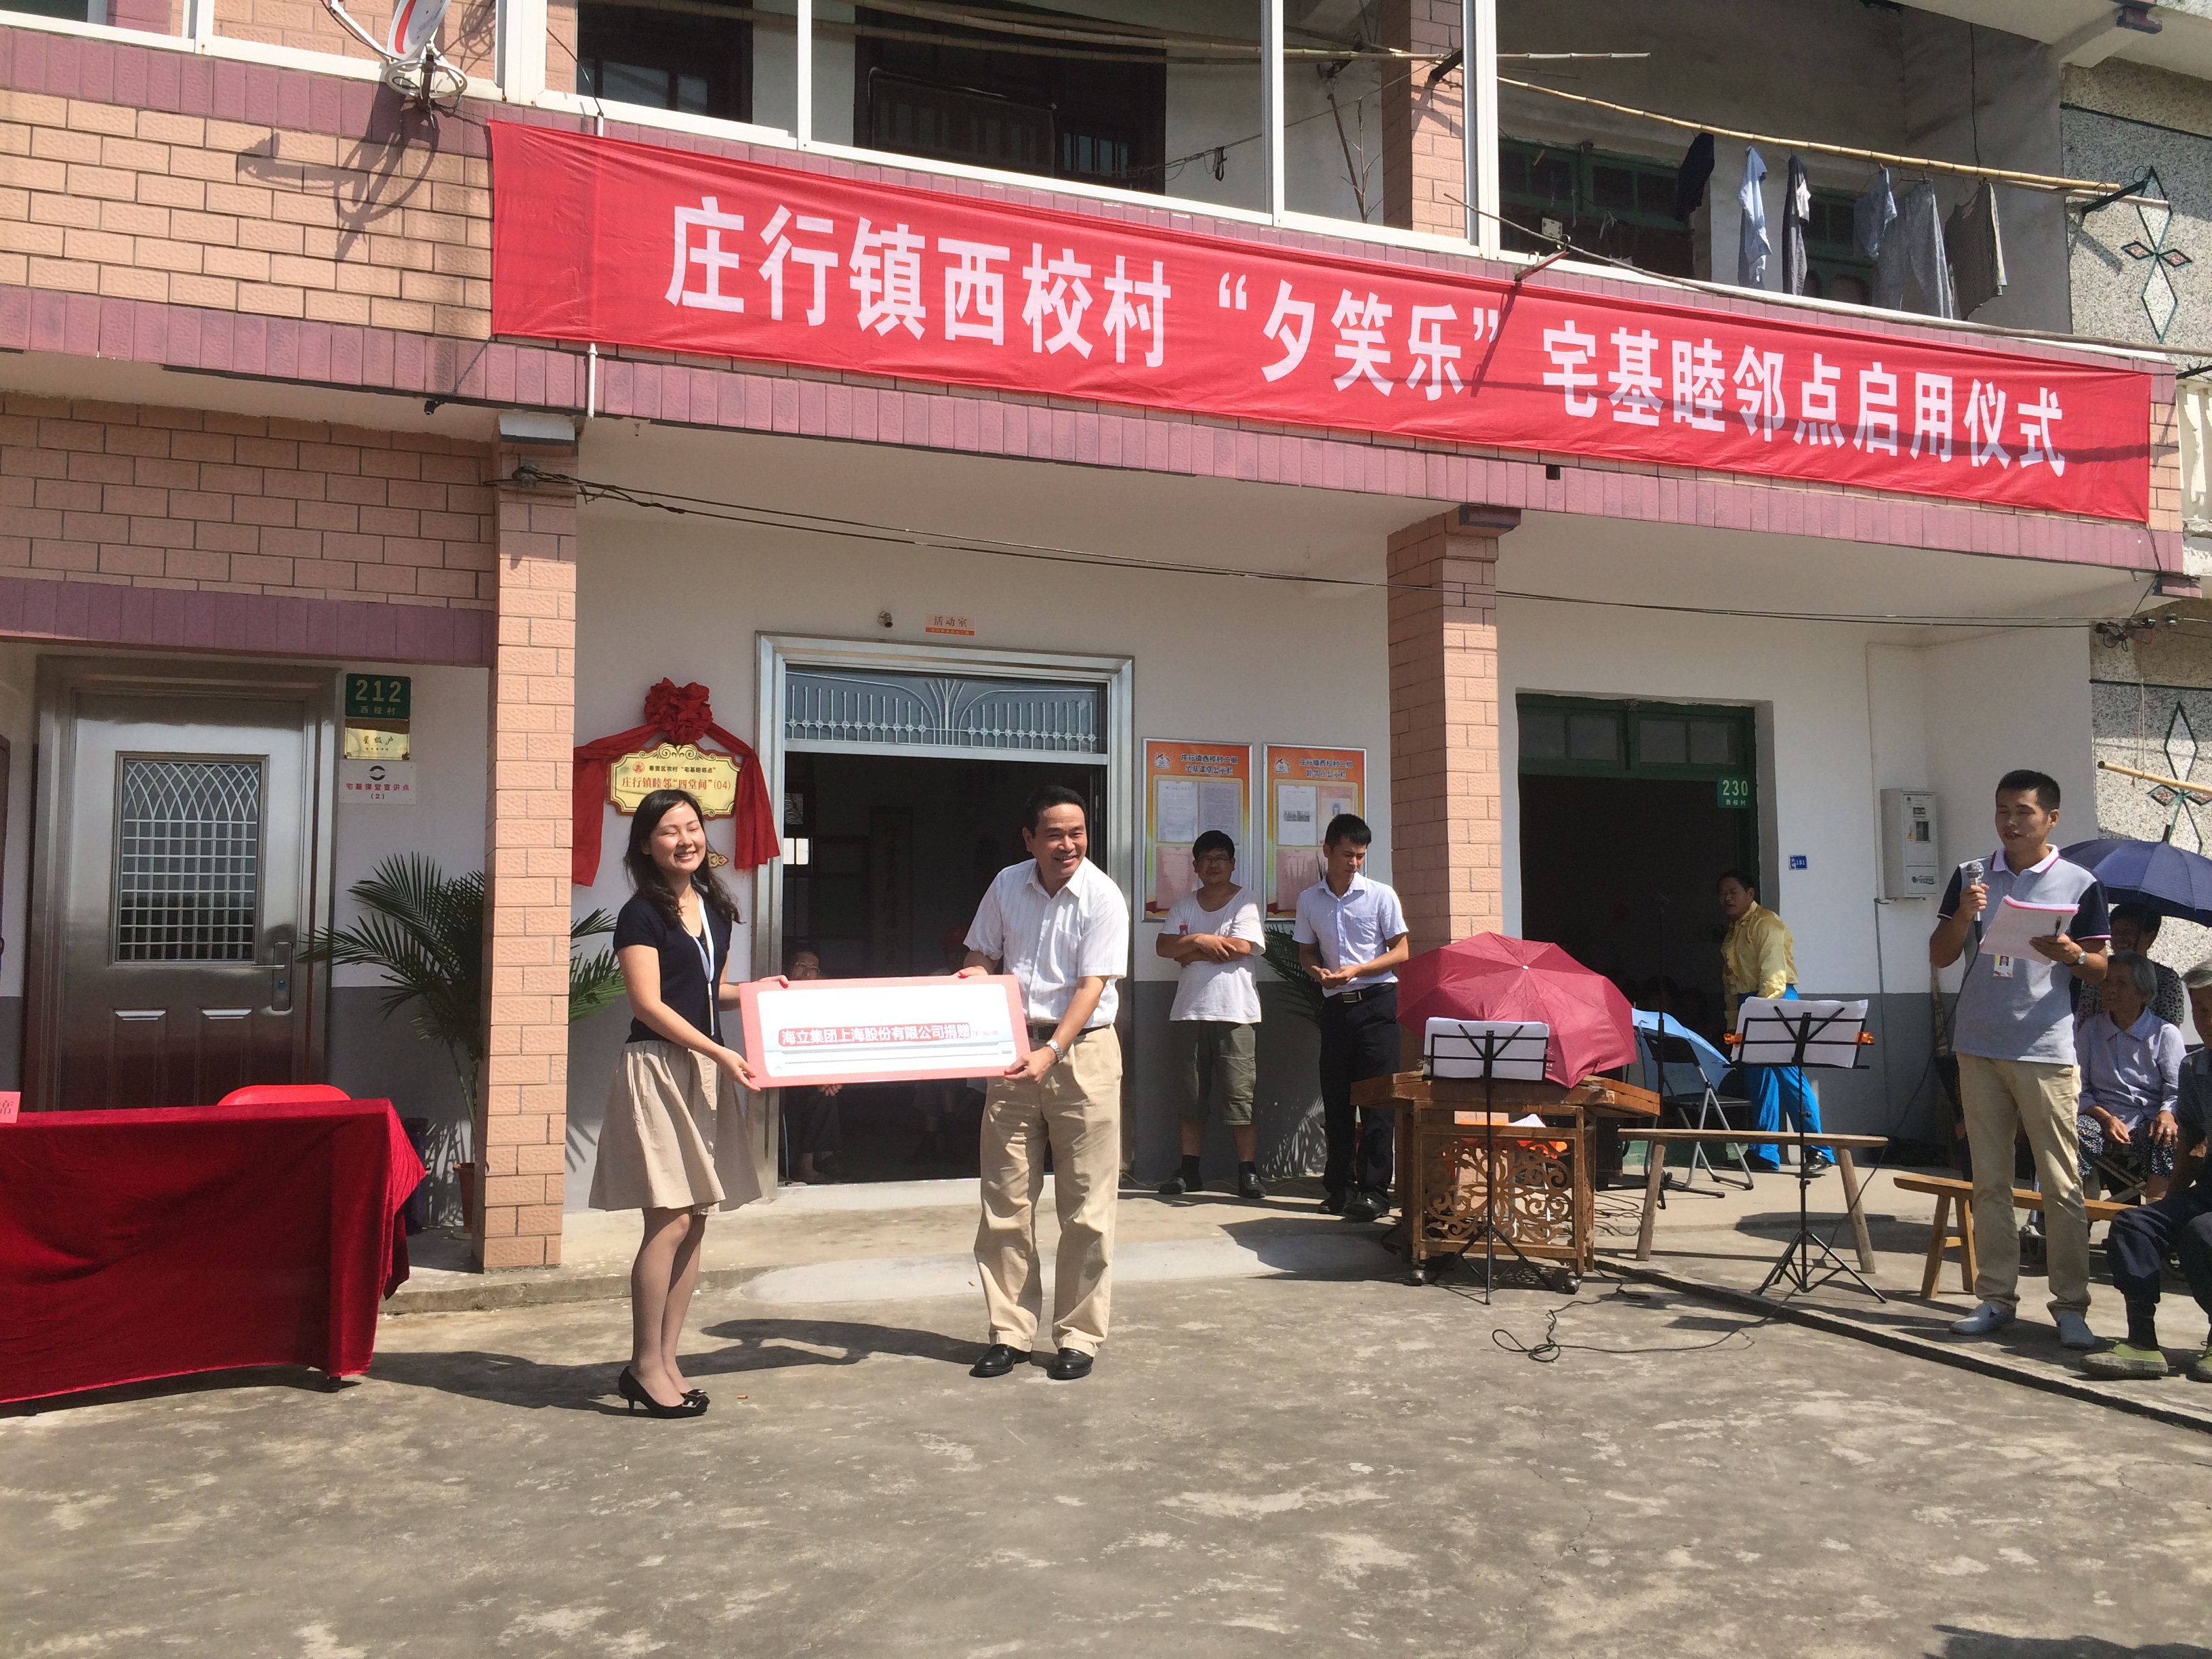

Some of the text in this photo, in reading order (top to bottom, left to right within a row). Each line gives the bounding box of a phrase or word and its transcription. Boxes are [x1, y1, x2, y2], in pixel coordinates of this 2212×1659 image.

[934, 616, 967, 628] 活动室
[355, 679, 402, 703] 212
[361, 705, 396, 715] 西校村
[1722, 779, 1748, 796] 230
[781, 1023, 970, 1045] 海立集团上海股份有限公司捐赠
